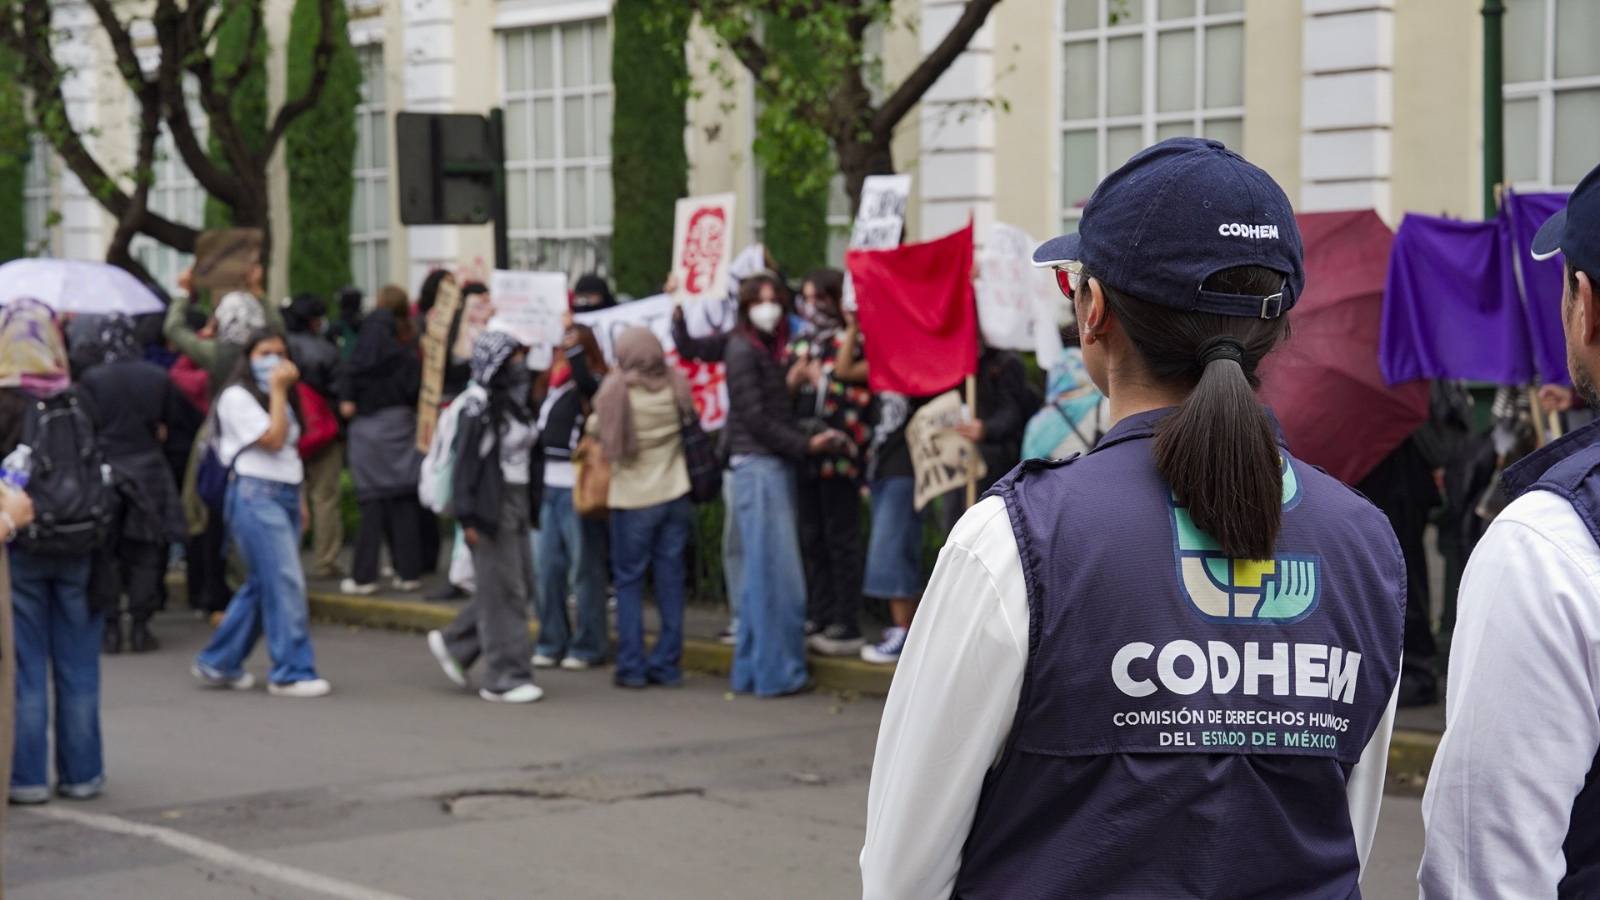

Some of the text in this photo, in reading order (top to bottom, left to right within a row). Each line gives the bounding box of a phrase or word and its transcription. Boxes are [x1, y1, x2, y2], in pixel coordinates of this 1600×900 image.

[1218, 223, 1279, 240] CODHEM
[1111, 639, 1362, 704] CODHEM
[1113, 706, 1205, 727] COMISIÓN
[1208, 709, 1223, 725] DE
[1226, 710, 1305, 727] DERECHOS
[1159, 729, 1337, 750] DEL ESTADO DE MÉXICO
